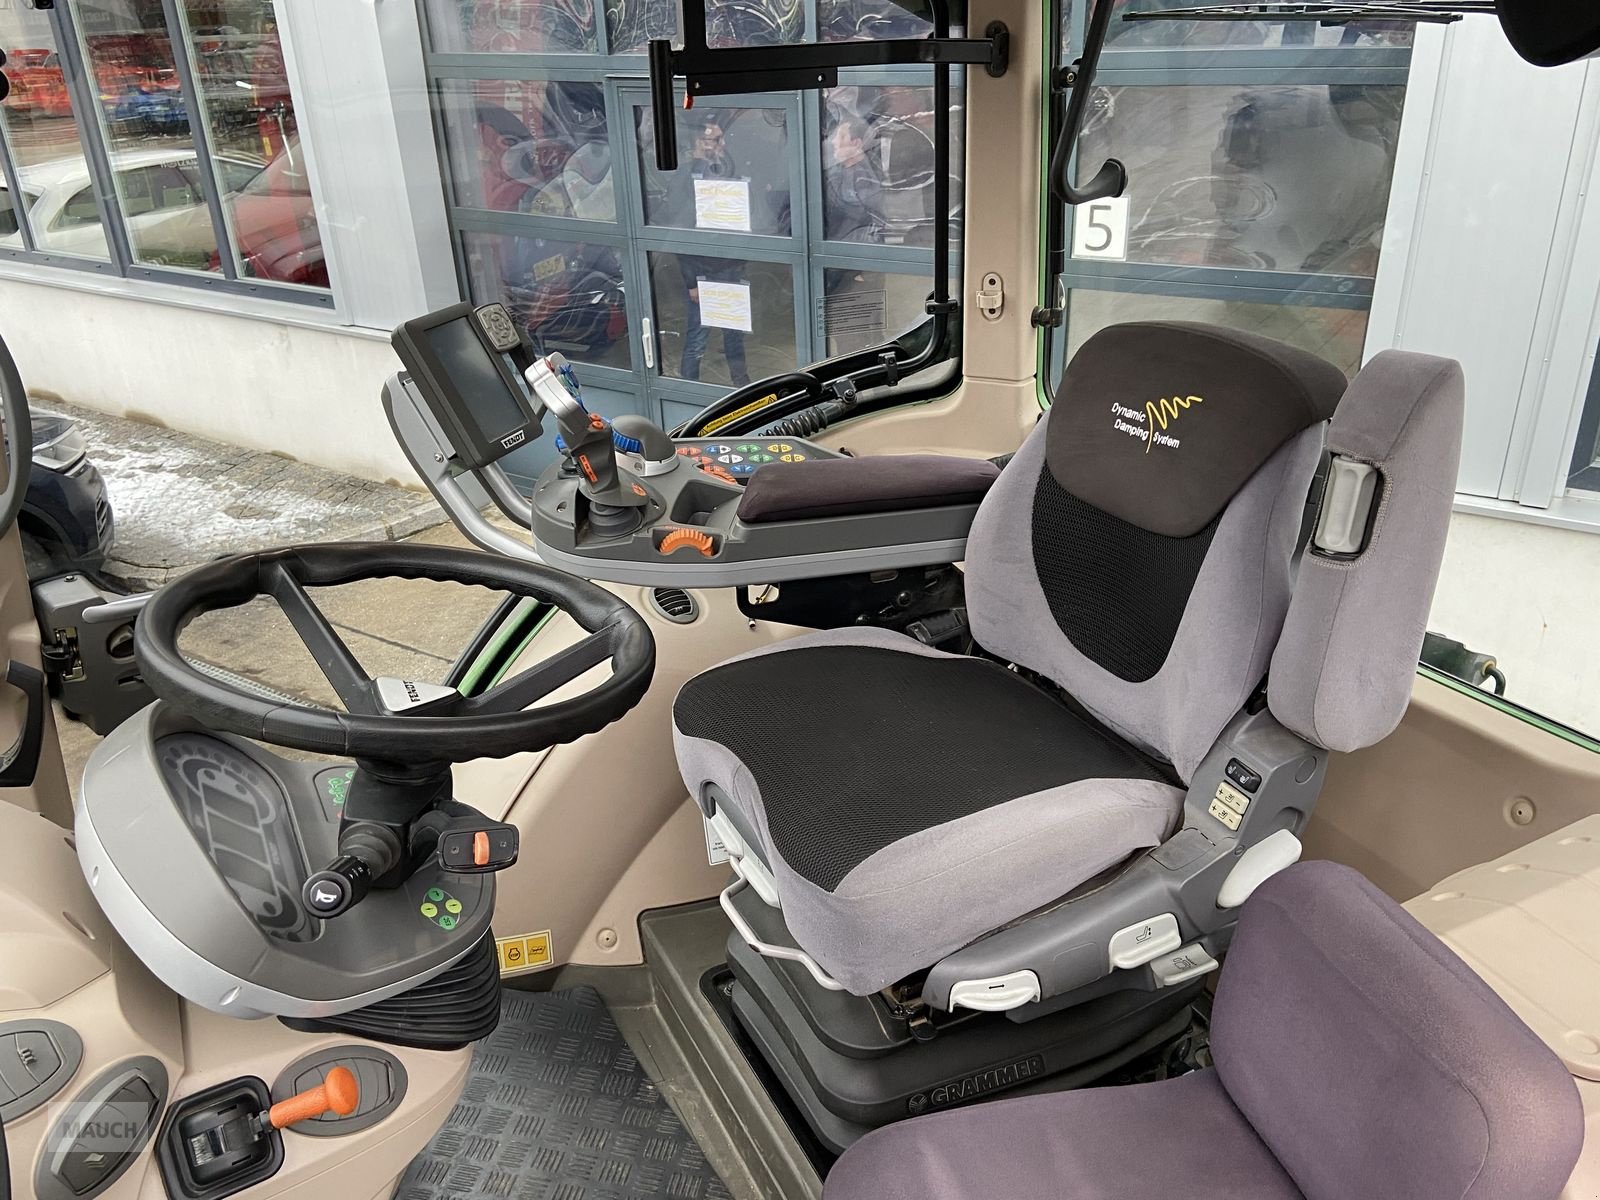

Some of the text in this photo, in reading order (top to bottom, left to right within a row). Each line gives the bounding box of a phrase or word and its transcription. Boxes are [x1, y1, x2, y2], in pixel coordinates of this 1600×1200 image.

[1084, 204, 1113, 252] 5
[1111, 402, 1146, 423] Dynamic
[502, 431, 525, 448] FENDT
[1113, 418, 1181, 449] Damping System
[402, 679, 421, 703] FENDT
[930, 1056, 1044, 1107] GRAMMER
